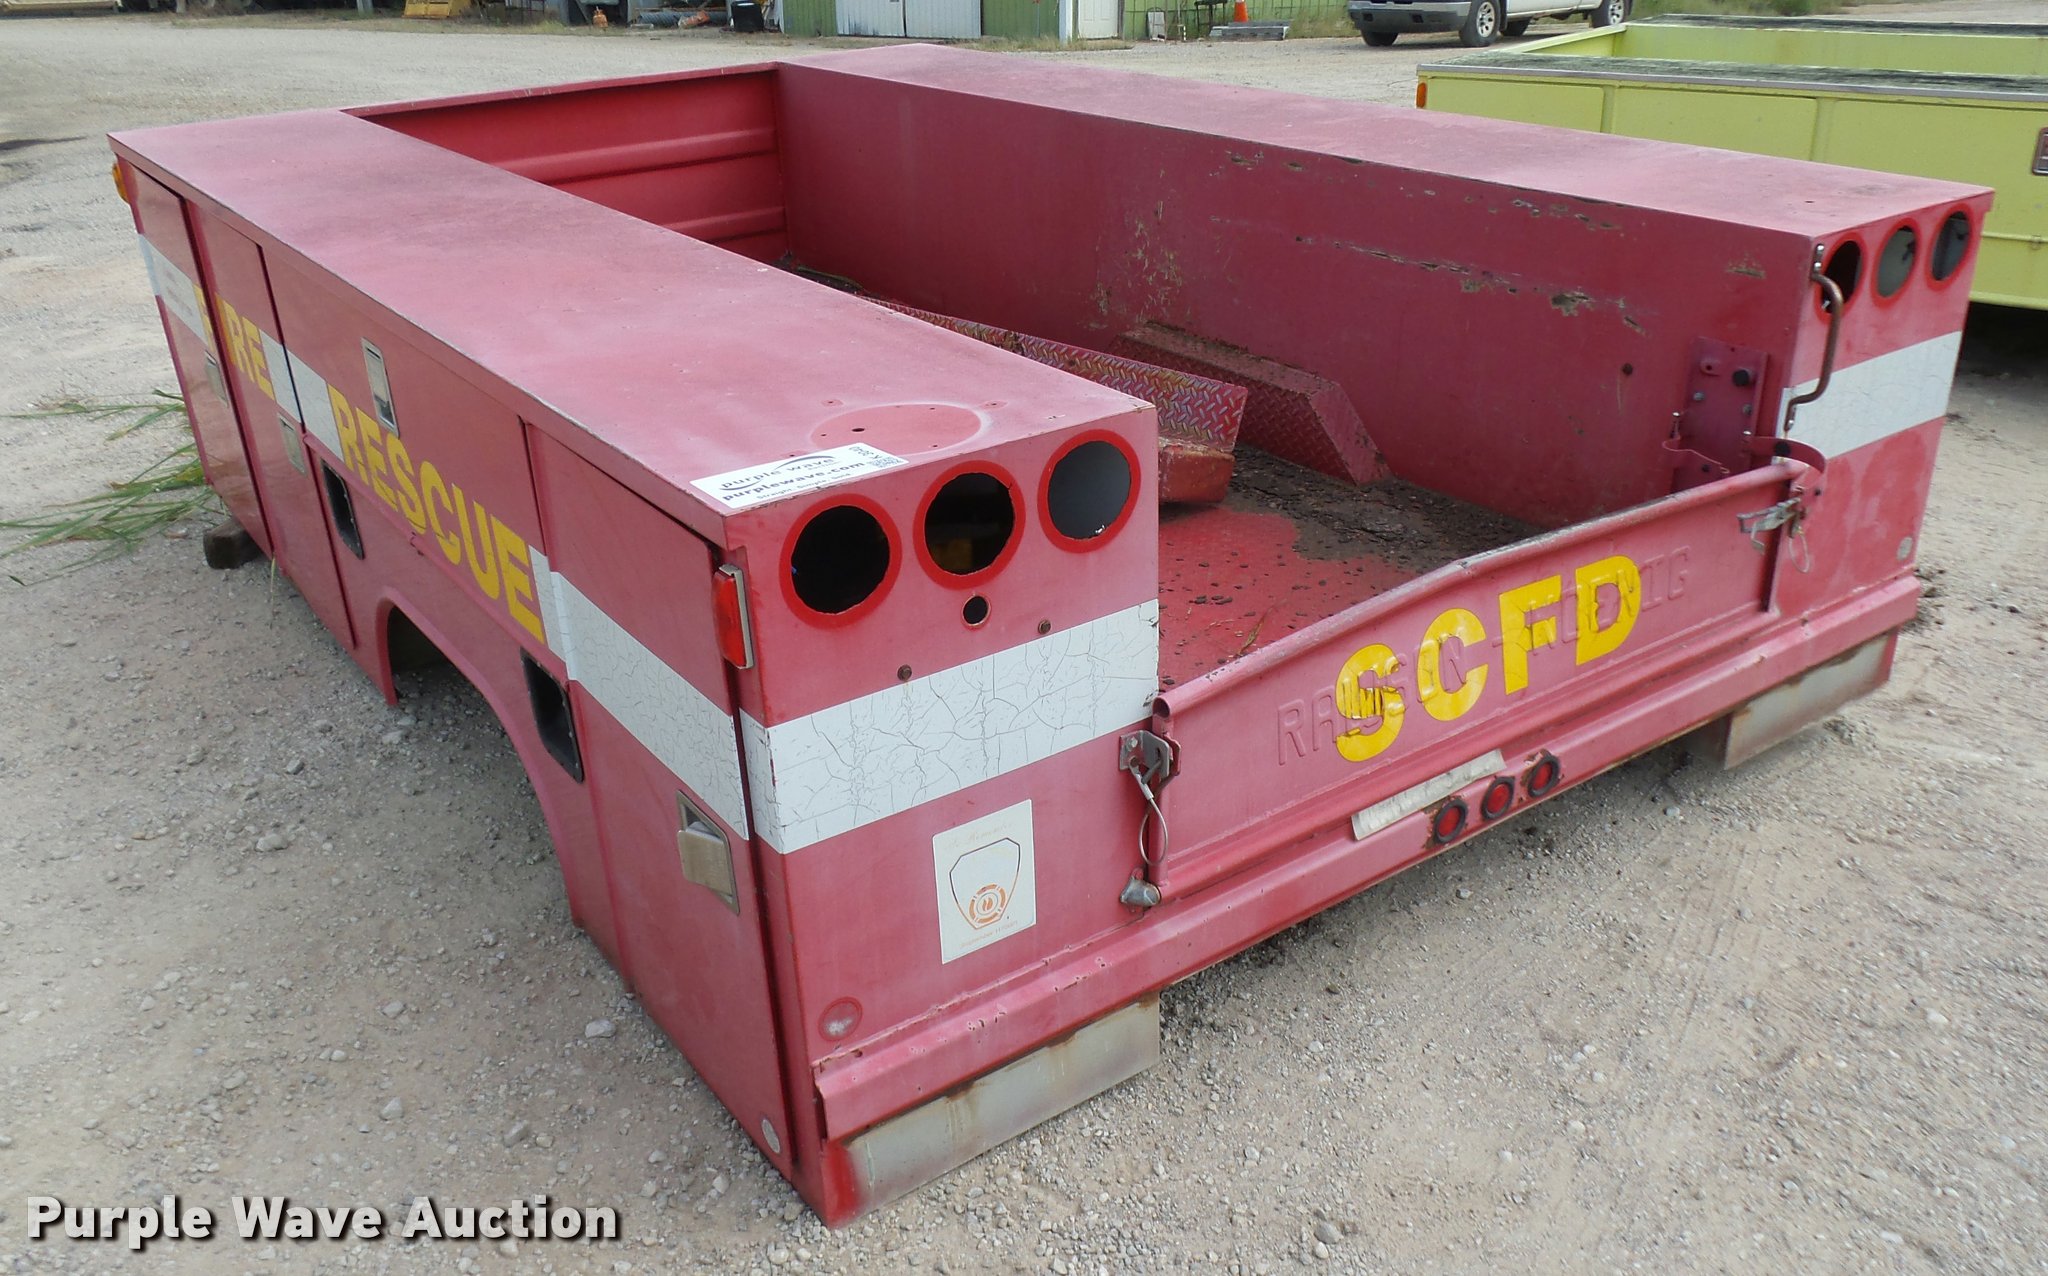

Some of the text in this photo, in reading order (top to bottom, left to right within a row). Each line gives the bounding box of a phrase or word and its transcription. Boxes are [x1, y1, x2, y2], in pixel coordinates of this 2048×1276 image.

[327, 382, 545, 643] RESCUE
[722, 470, 780, 489] purple
[787, 458, 834, 471] wave
[722, 461, 865, 501] purplewave.com
[1336, 555, 1641, 762] SCFD
